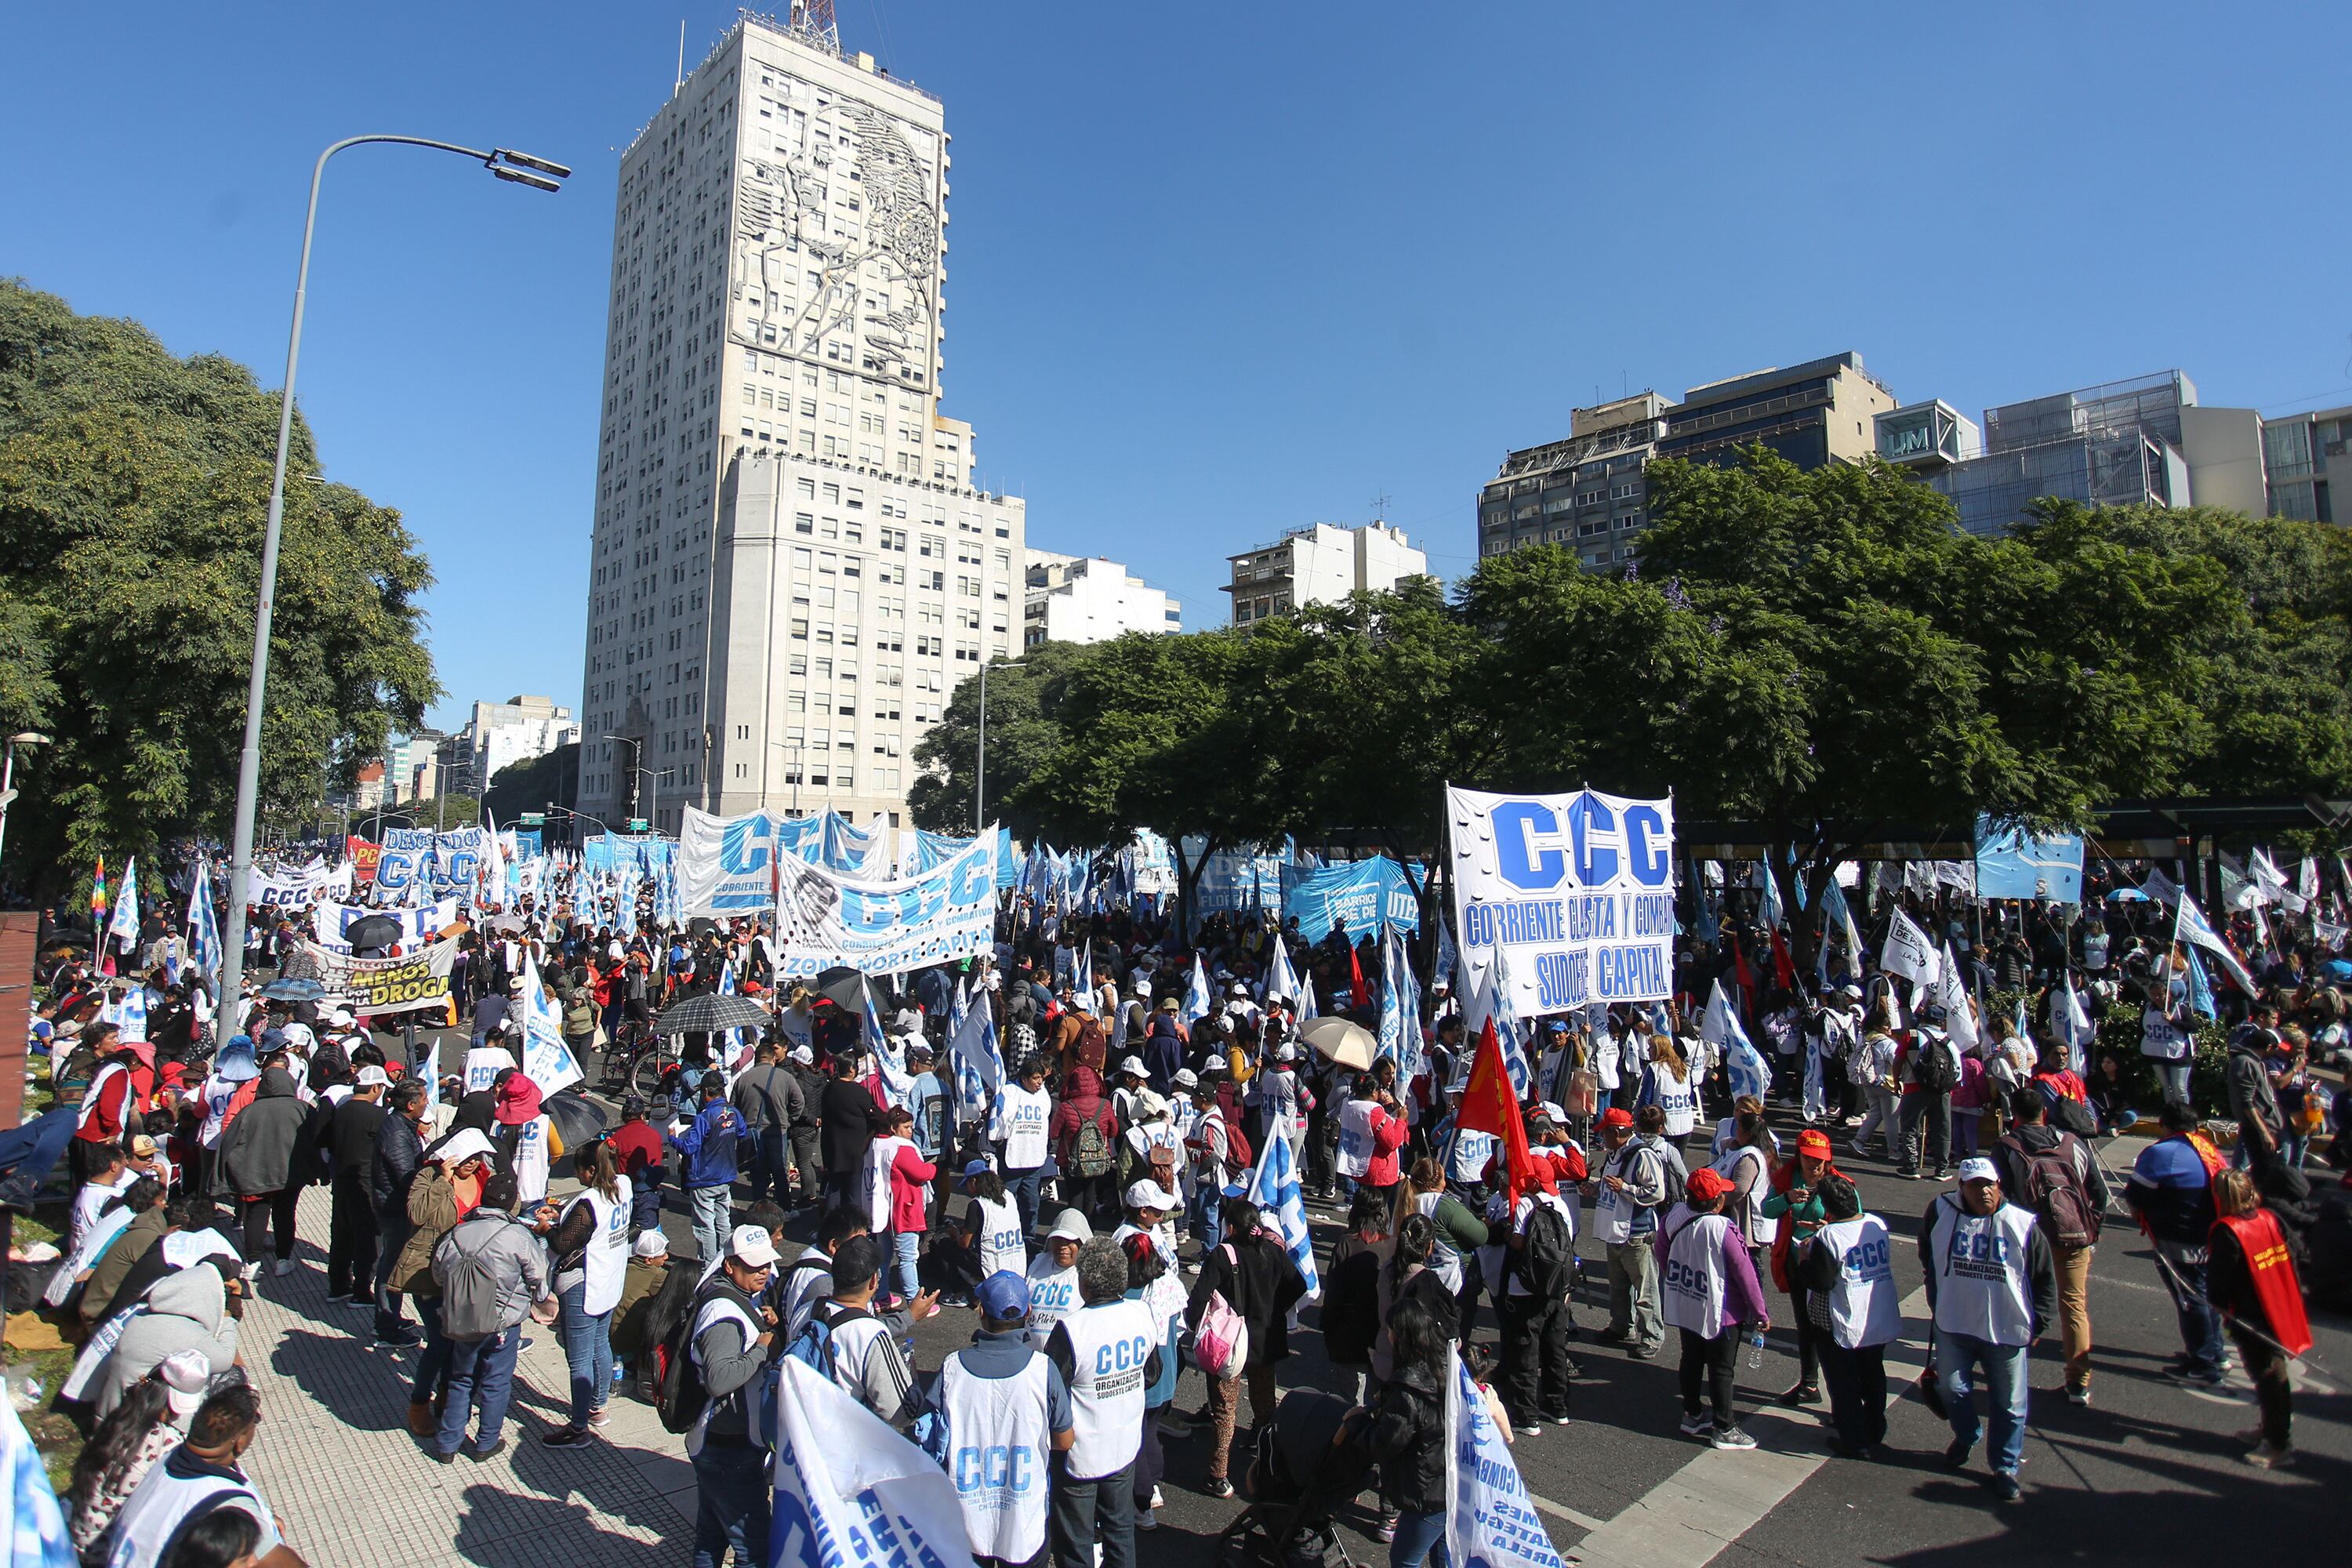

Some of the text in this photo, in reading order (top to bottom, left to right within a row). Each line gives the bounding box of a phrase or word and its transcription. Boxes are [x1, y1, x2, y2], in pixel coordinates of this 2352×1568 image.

[720, 813, 869, 875] CCC
[1487, 792, 1670, 893] CCC
[357, 847, 379, 864] PC
[329, 884, 346, 896] CC
[714, 880, 764, 892] CORRIENTE
[840, 848, 991, 935] CCC
[261, 887, 309, 906] CCC
[1334, 892, 1377, 910] BARRIOS
[946, 906, 993, 927] COMBATIVA
[1362, 905, 1377, 919] PIE
[1465, 899, 1566, 947] CORRIENTE
[1621, 892, 1632, 940] Y
[857, 944, 923, 972] NORTE
[351, 960, 431, 988] MENOS
[1596, 943, 1668, 1000] CAPITAL
[348, 988, 372, 997] POR
[372, 975, 449, 1005] DROGA
[355, 997, 371, 1006] LA
[2146, 1024, 2173, 1040] CCC
[471, 1066, 501, 1083] CCC
[1016, 1105, 1042, 1121] CCC
[746, 1229, 766, 1243] CCC
[1846, 1239, 1888, 1271] CCC
[1951, 1231, 2010, 1262] CCC
[1665, 1258, 1708, 1294] CCC
[1030, 1281, 1073, 1306] CCC
[1036, 1312, 1056, 1324] Pileto
[1095, 1335, 1146, 1375] CCC
[1097, 1388, 1125, 1400] SUDOESTE
[956, 1445, 1032, 1493] CCC
[978, 1500, 1011, 1512] CHILAVERT
